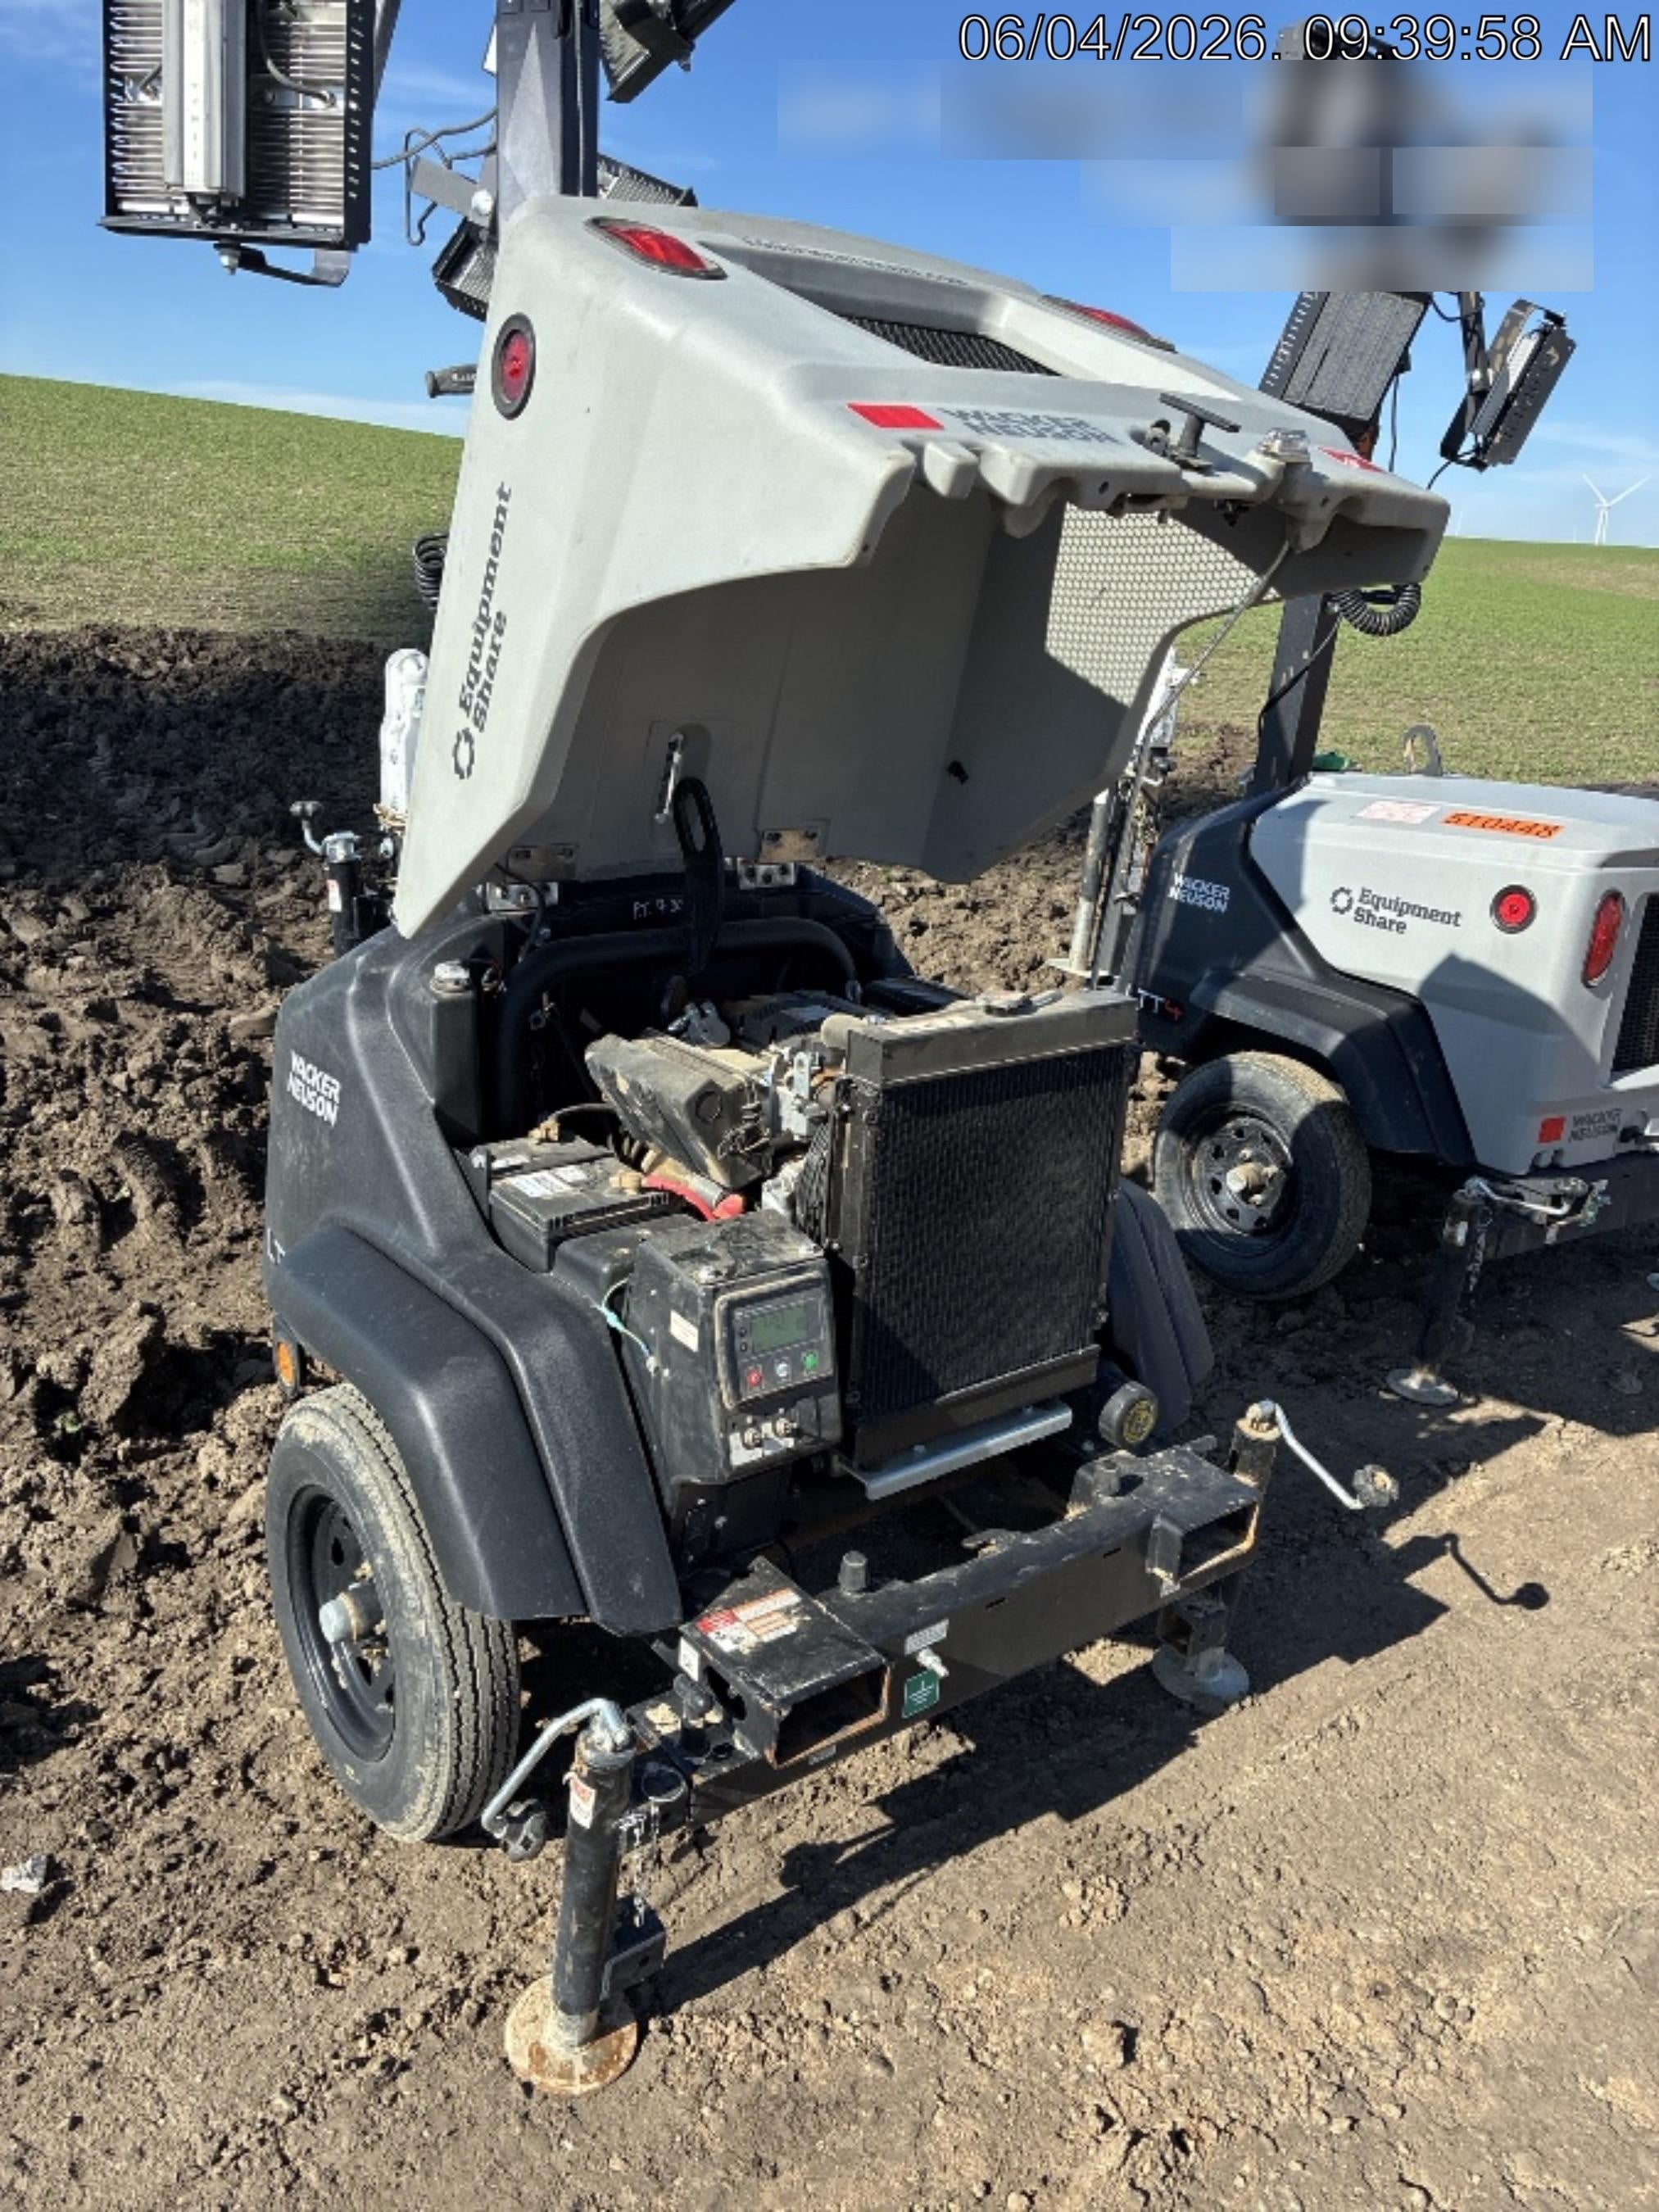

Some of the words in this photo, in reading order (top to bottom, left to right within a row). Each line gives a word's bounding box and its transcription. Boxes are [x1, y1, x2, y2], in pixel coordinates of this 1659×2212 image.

[459, 482, 511, 718] Equipment
[473, 611, 506, 733] Share
[1167, 886, 1228, 913] NEUSON
[1174, 872, 1230, 900] WACKER
[1358, 886, 1462, 927] Equipment
[1353, 906, 1407, 934] Share
[287, 1071, 338, 1126] NEUSON
[291, 1049, 341, 1104] WACKER
